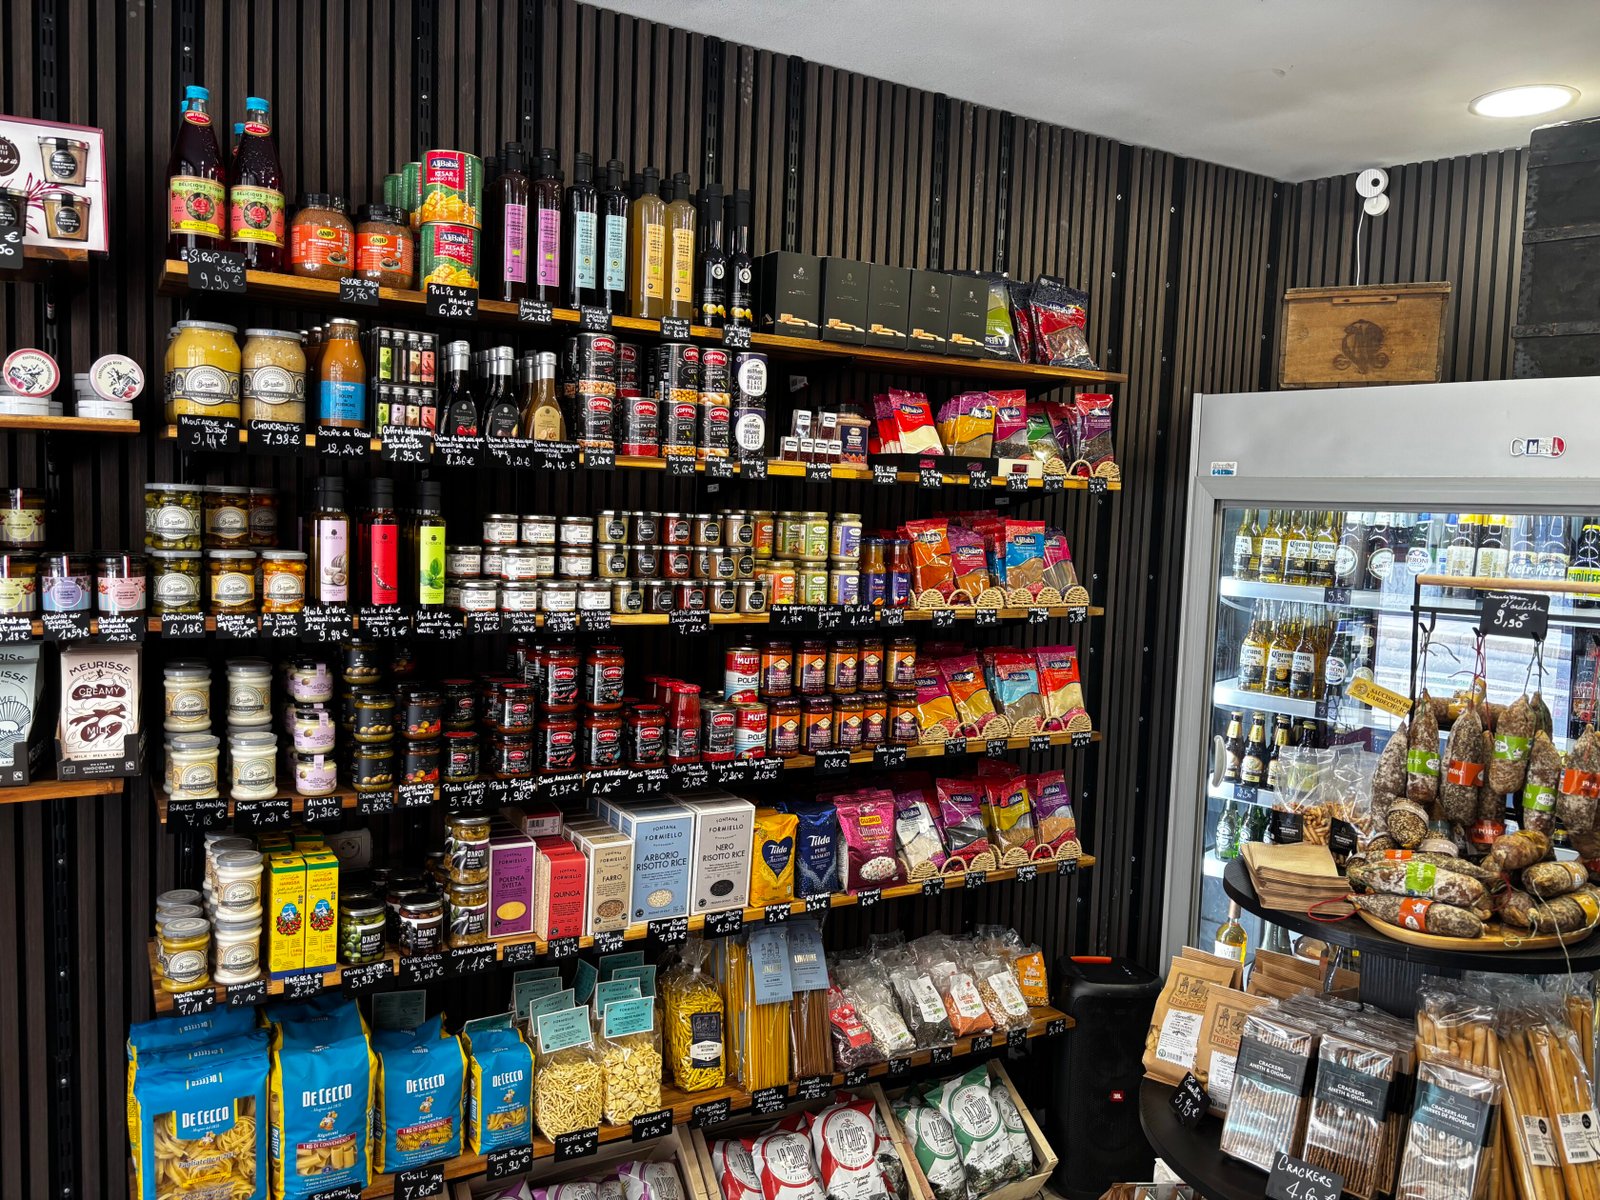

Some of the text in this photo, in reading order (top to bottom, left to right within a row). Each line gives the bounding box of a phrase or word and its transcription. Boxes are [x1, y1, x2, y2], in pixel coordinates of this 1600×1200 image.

[593, 338, 615, 350] COPPOLA
[703, 354, 727, 364] COPPOLA
[588, 398, 612, 409] COPPOLA
[634, 402, 657, 413] COPPOLA
[674, 407, 695, 418] COPPOLA
[1313, 541, 1335, 550] Corona
[1536, 565, 1564, 577] Pietra
[70, 661, 131, 676] MEURISSE
[79, 687, 120, 695] CREAMY
[1370, 688, 1402, 707] SAUCISSON
[87, 725, 111, 735] MILK
[652, 824, 676, 832] FONTANA
[708, 823, 744, 833] FORMIELLO
[1478, 828, 1499, 836] PORC
[644, 831, 683, 841] FORMIELLO
[806, 834, 831, 846] Tilda
[715, 843, 735, 851] NERO
[769, 843, 788, 855] Tilda
[467, 850, 484, 858] D'ARCO
[643, 851, 679, 862] ARBORIO
[702, 849, 746, 862] RISOTTO RICE
[636, 857, 687, 871] RISOTTO RICE
[602, 873, 623, 882] FARRO
[553, 890, 580, 898] QUINOA
[469, 914, 485, 923] D'ARCO
[362, 933, 381, 945] D'ARCO
[417, 928, 437, 938] D'ARCO
[1249, 1062, 1267, 1075] ANETH
[1270, 1068, 1292, 1082] OIGNON
[1258, 1059, 1285, 1073] CRACKERS
[406, 1073, 445, 1094] DE CECCO
[492, 1069, 523, 1087] DE CECCO
[303, 1083, 352, 1108] DE CECCO
[1327, 1085, 1346, 1098] ANETH
[1350, 1092, 1374, 1106] OIGNON
[1337, 1083, 1366, 1098] CRACKERS
[182, 1106, 229, 1129] DE CECCO
[962, 1105, 974, 1124] LA
[1421, 1104, 1476, 1130] HERBES DE PROVENCE
[1431, 1103, 1468, 1120] CRACKERS AUX
[836, 1124, 868, 1153] LA CHIPS
[1278, 1154, 1333, 1188] CRACKERS
